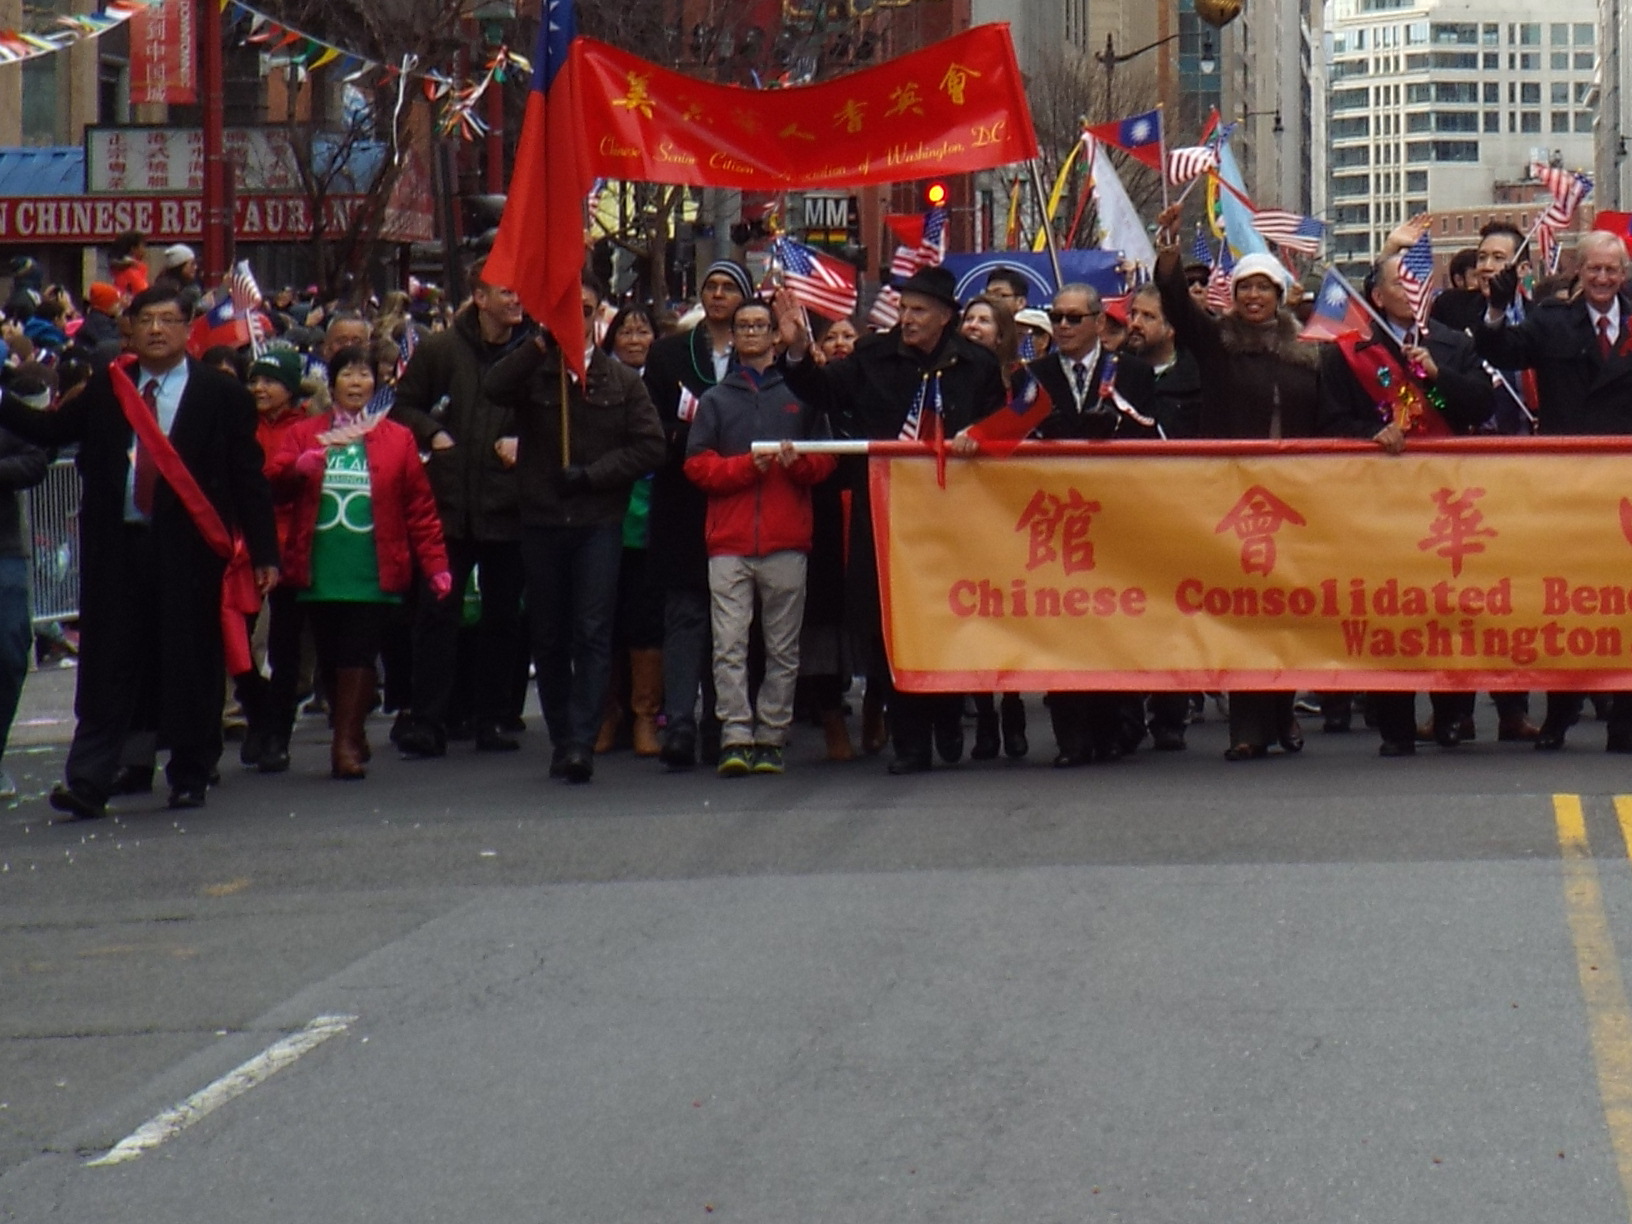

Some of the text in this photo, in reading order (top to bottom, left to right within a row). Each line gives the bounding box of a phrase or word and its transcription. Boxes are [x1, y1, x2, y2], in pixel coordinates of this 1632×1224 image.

[858, 153, 869, 175] of
[15, 200, 153, 235] CHINESE
[948, 579, 1147, 618] Chinese
[1175, 576, 1513, 618] Consolidated
